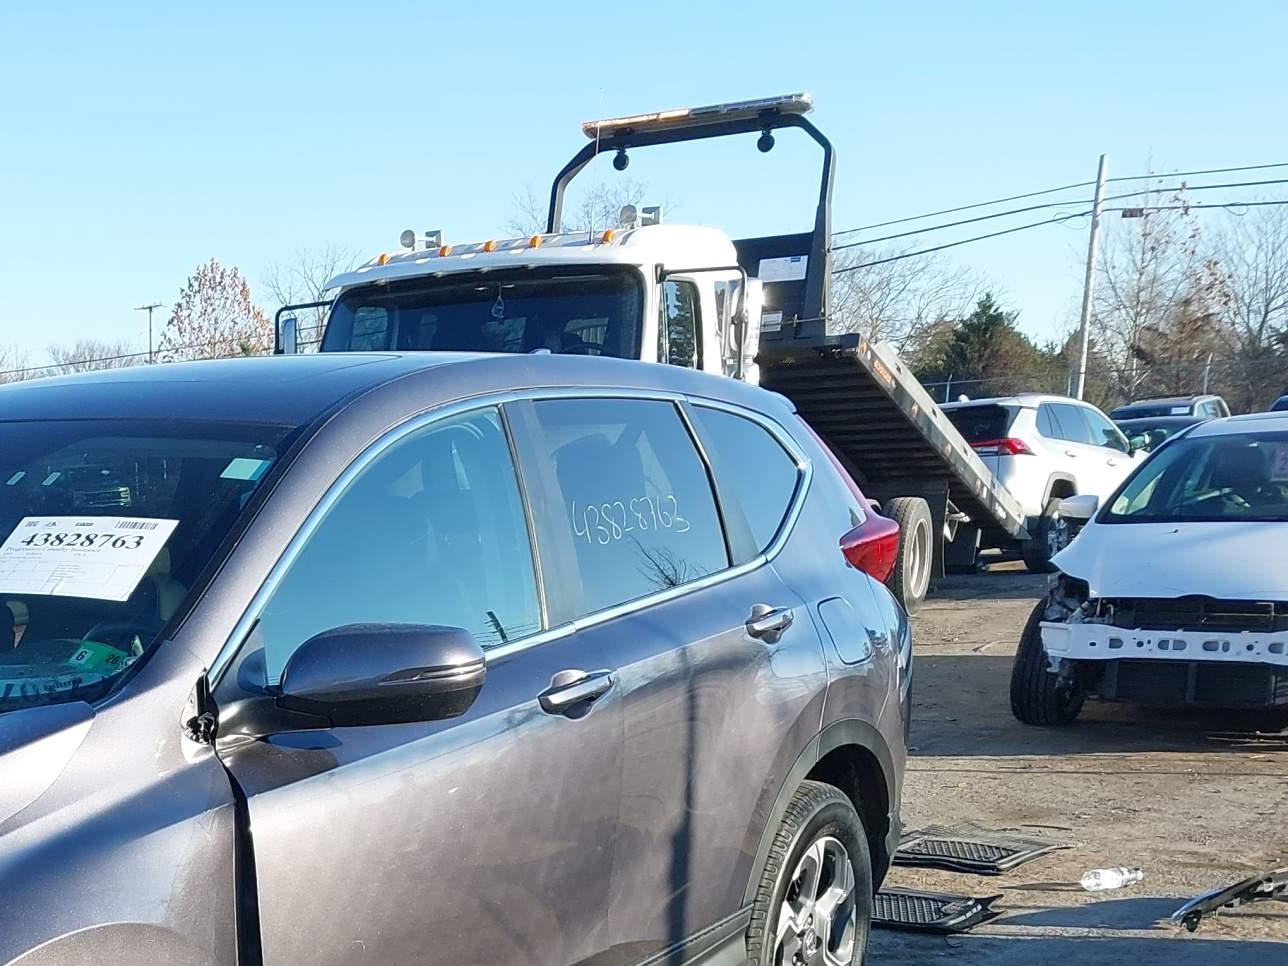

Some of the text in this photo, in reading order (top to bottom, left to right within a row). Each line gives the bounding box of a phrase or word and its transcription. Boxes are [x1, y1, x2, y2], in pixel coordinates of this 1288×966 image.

[572, 495, 691, 545] 43828763
[20, 532, 145, 550] 43828763
[75, 650, 88, 661] 6
